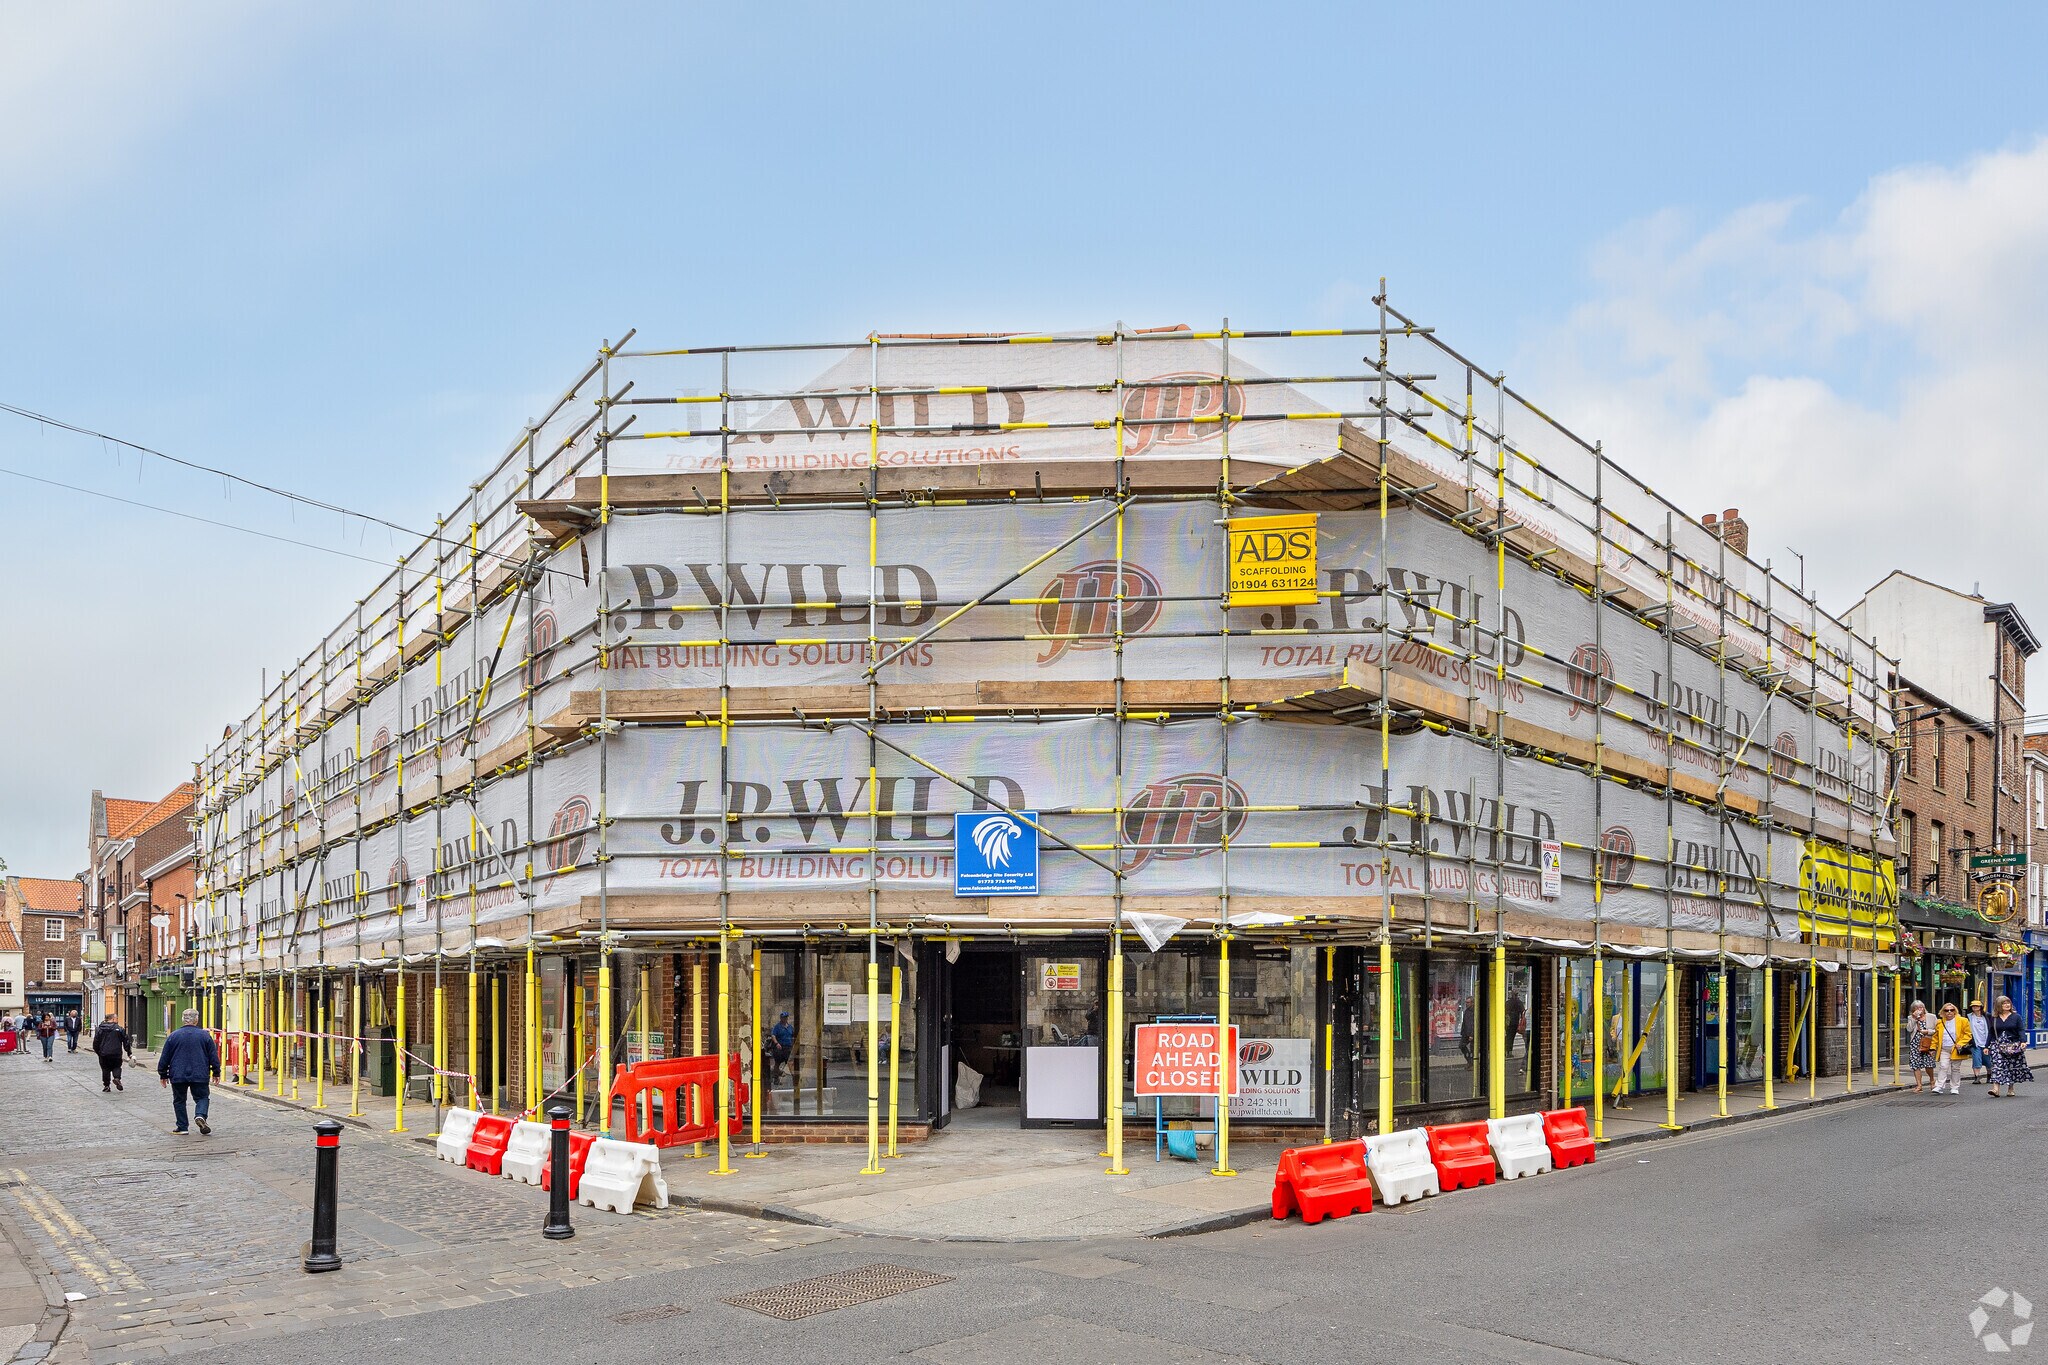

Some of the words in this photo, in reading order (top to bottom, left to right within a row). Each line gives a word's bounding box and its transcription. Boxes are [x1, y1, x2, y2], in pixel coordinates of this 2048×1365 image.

[877, 445, 1021, 467] SOLUTIONS
[1237, 531, 1312, 562] ADS
[1240, 566, 1306, 576] SCAFFOLDING
[1231, 579, 1268, 589] 01904
[1271, 577, 1314, 588] 631124
[1037, 572, 1143, 664] JP
[657, 645, 780, 669] BUILDING
[1261, 645, 1336, 667] TOTAL
[1452, 660, 1524, 704] SOUTIONS
[1122, 784, 1231, 872] JP
[544, 804, 586, 893] JP
[740, 857, 864, 879] BUILDING
[1341, 863, 1420, 891] TOTAL
[1158, 1033, 1214, 1048] ROAD
[1151, 1052, 1220, 1067] AHEAD
[1240, 1042, 1268, 1067] JP
[1241, 1069, 1302, 1086] WILD
[1264, 1087, 1301, 1095] SOLUTIONS
[1247, 1098, 1264, 1107] 242
[1267, 1098, 1288, 1107] 8411
